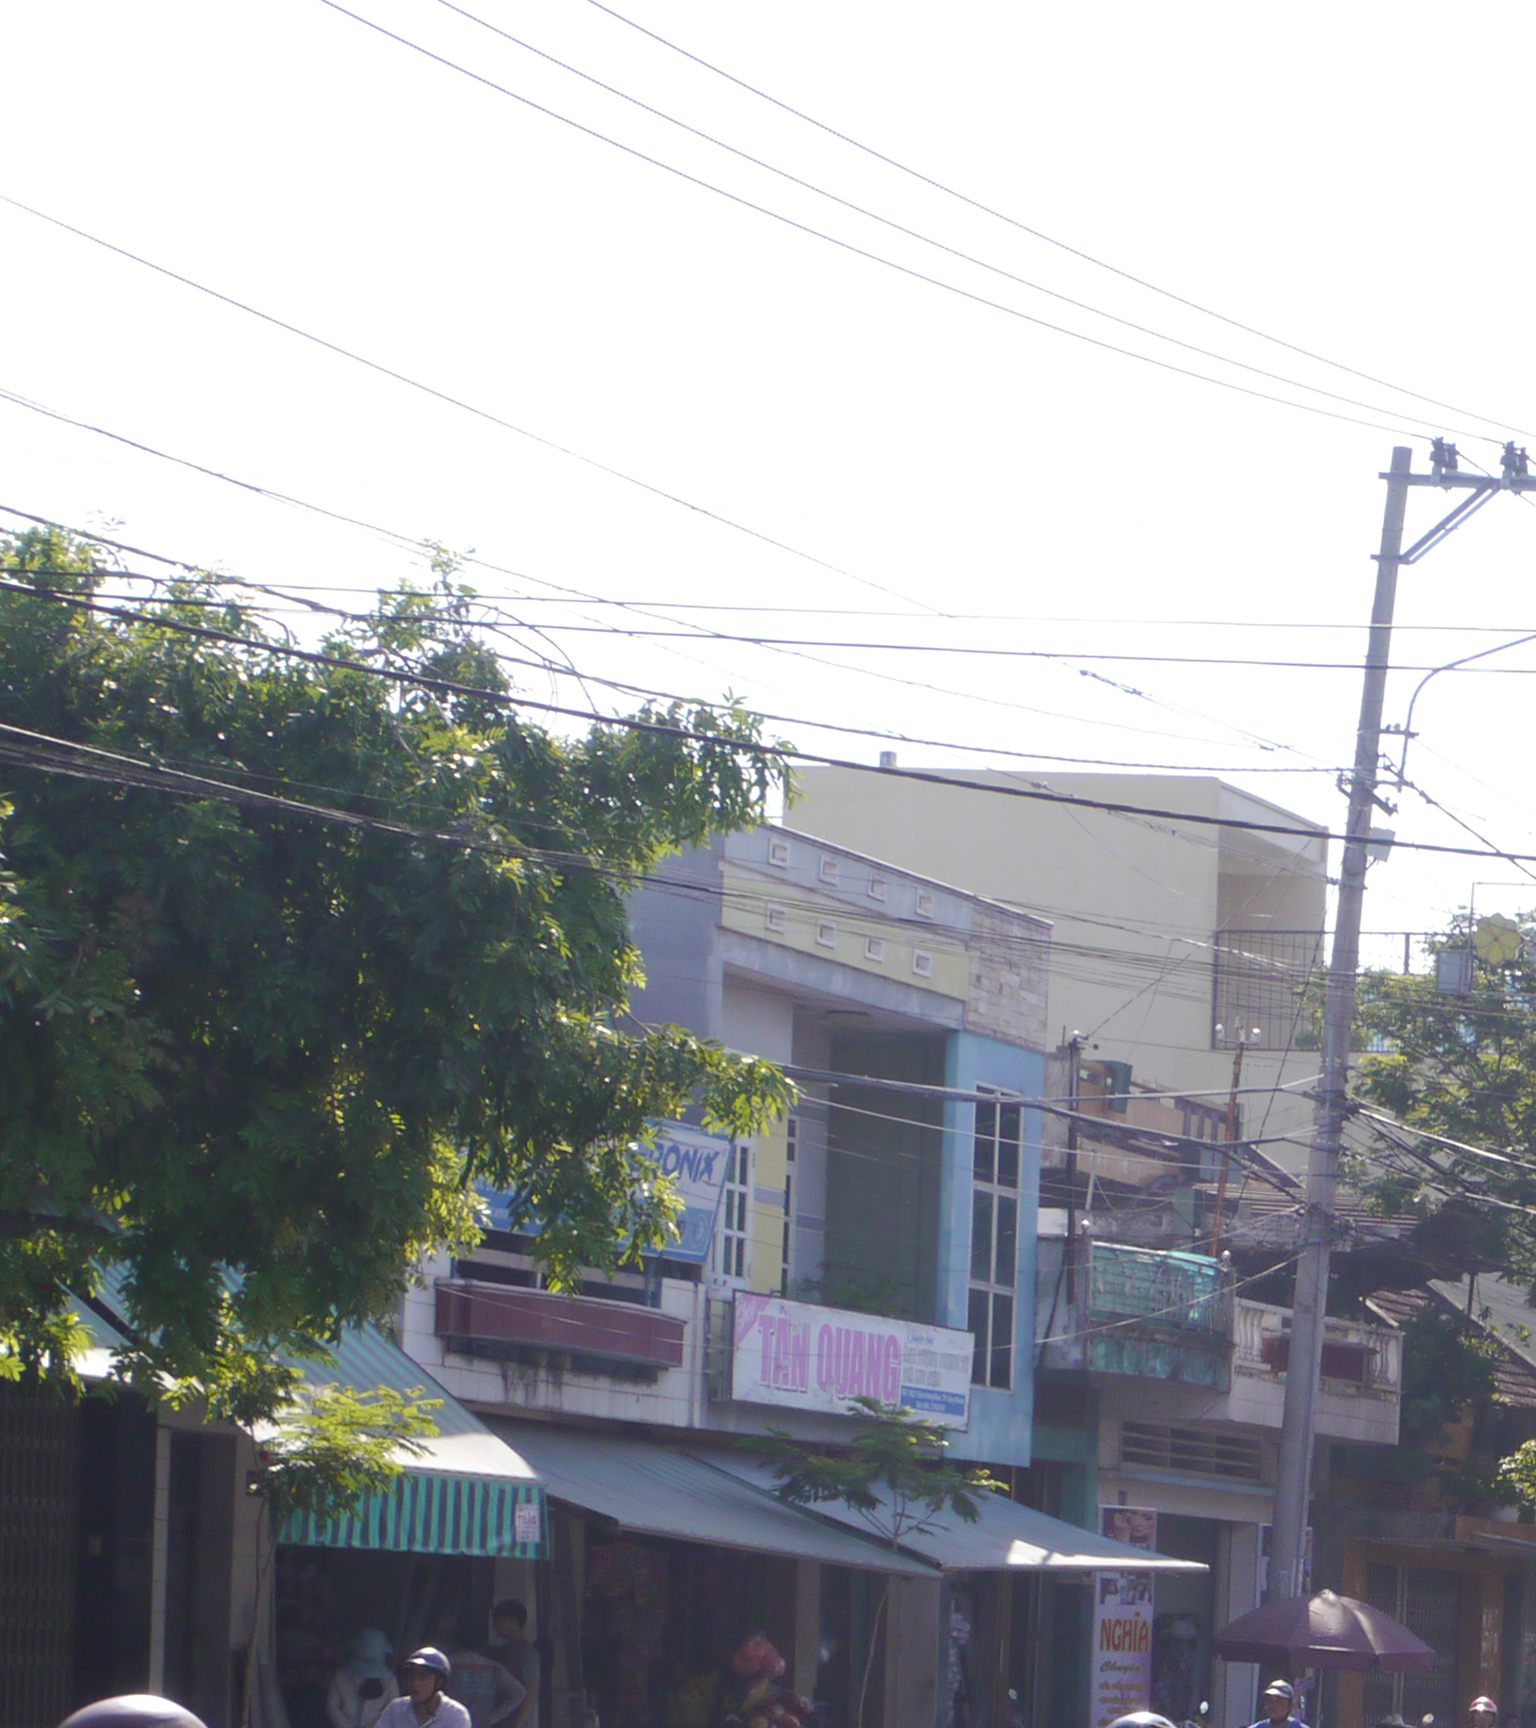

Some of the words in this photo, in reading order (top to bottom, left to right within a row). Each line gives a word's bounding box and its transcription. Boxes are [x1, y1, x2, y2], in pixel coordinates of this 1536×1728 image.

[758, 1305, 810, 1394] TÂN
[816, 1323, 902, 1408] QUANG
[1100, 1612, 1150, 1652] NGHĨA
